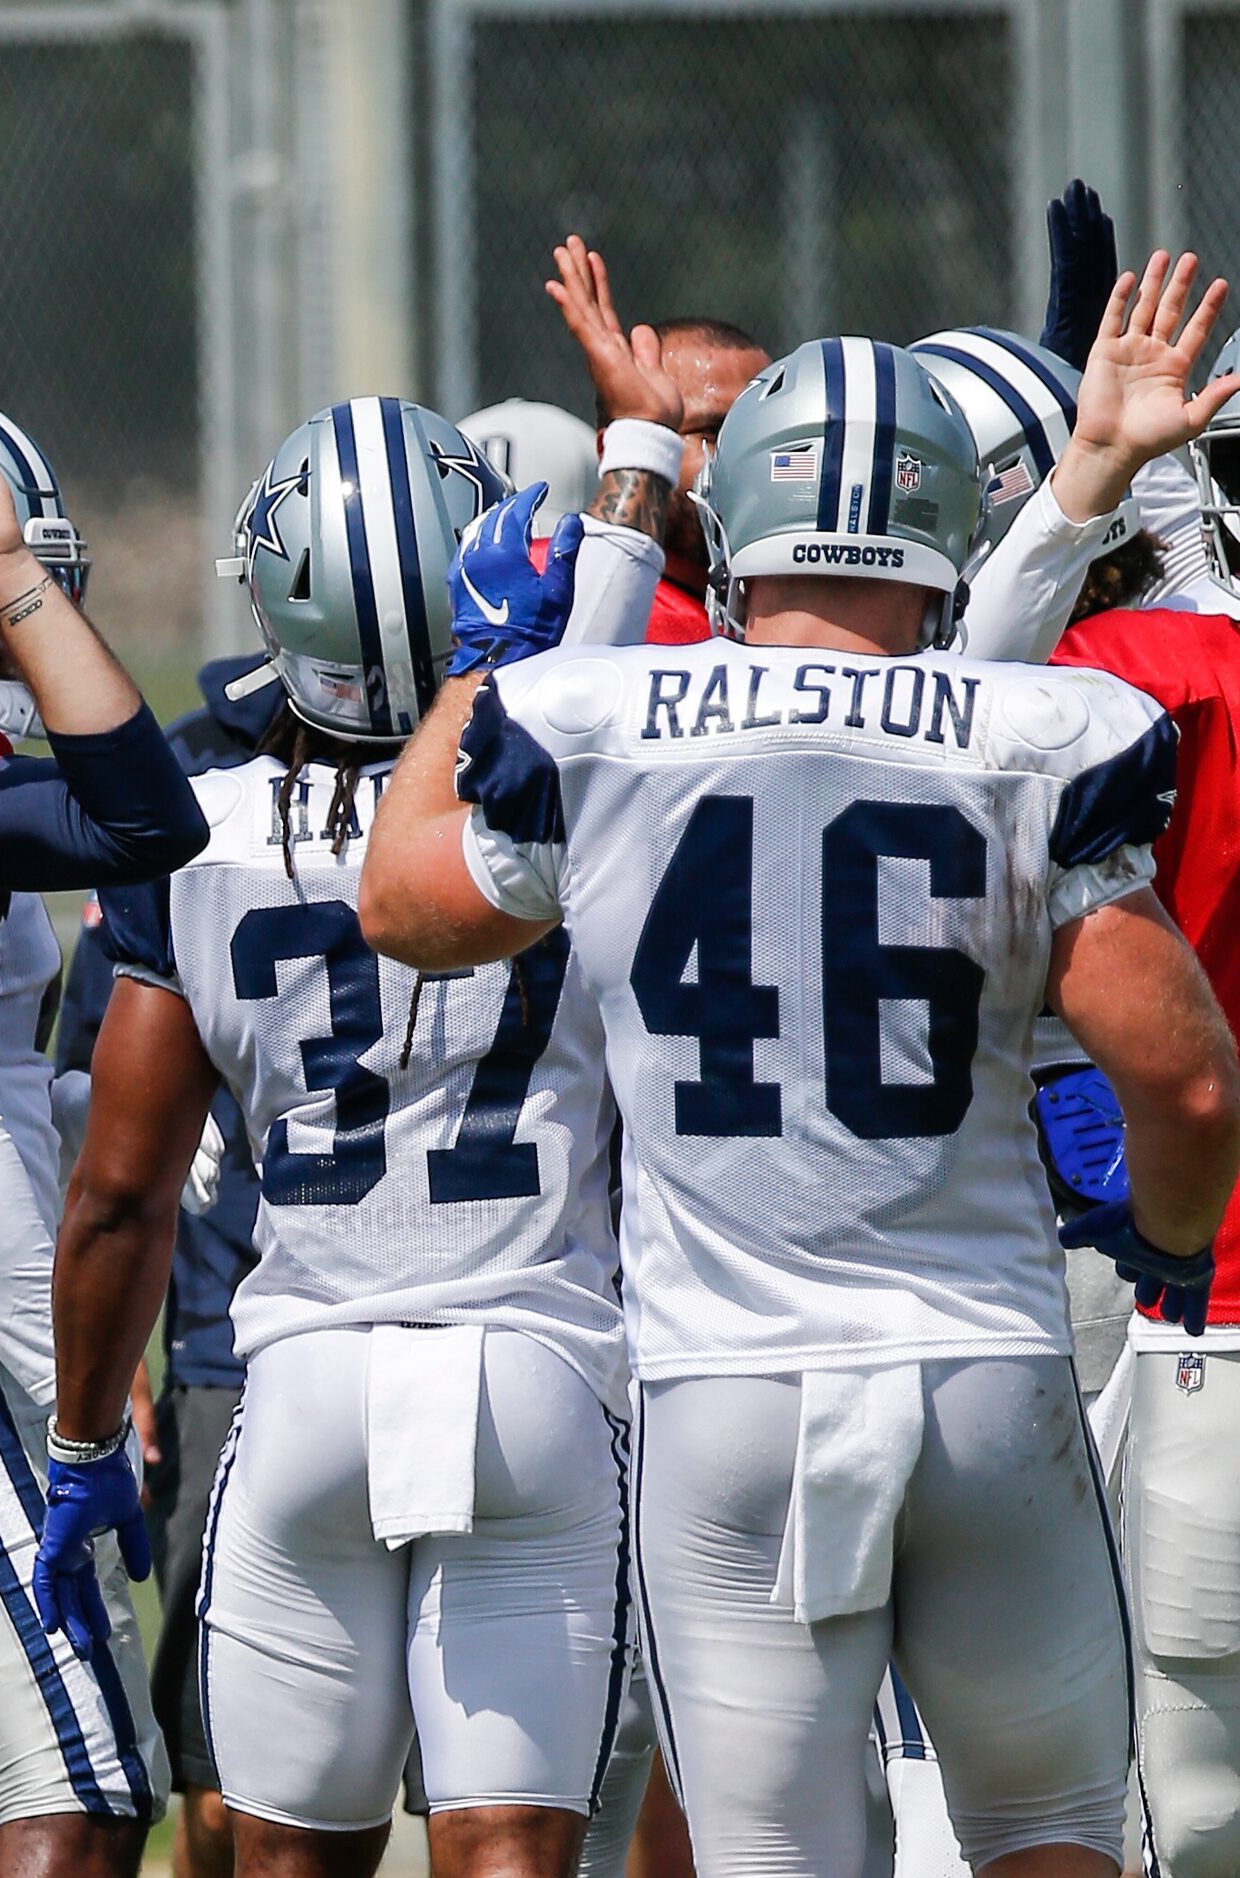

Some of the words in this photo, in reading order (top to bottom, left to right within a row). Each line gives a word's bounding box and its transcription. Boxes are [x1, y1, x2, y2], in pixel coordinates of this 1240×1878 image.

[899, 471, 919, 487] NFL
[793, 544, 904, 568] COWBOYS
[640, 664, 982, 749] RALSTON
[629, 795, 987, 1139] 46
[230, 900, 572, 1206] 37
[1179, 1369, 1199, 1386] NFL
